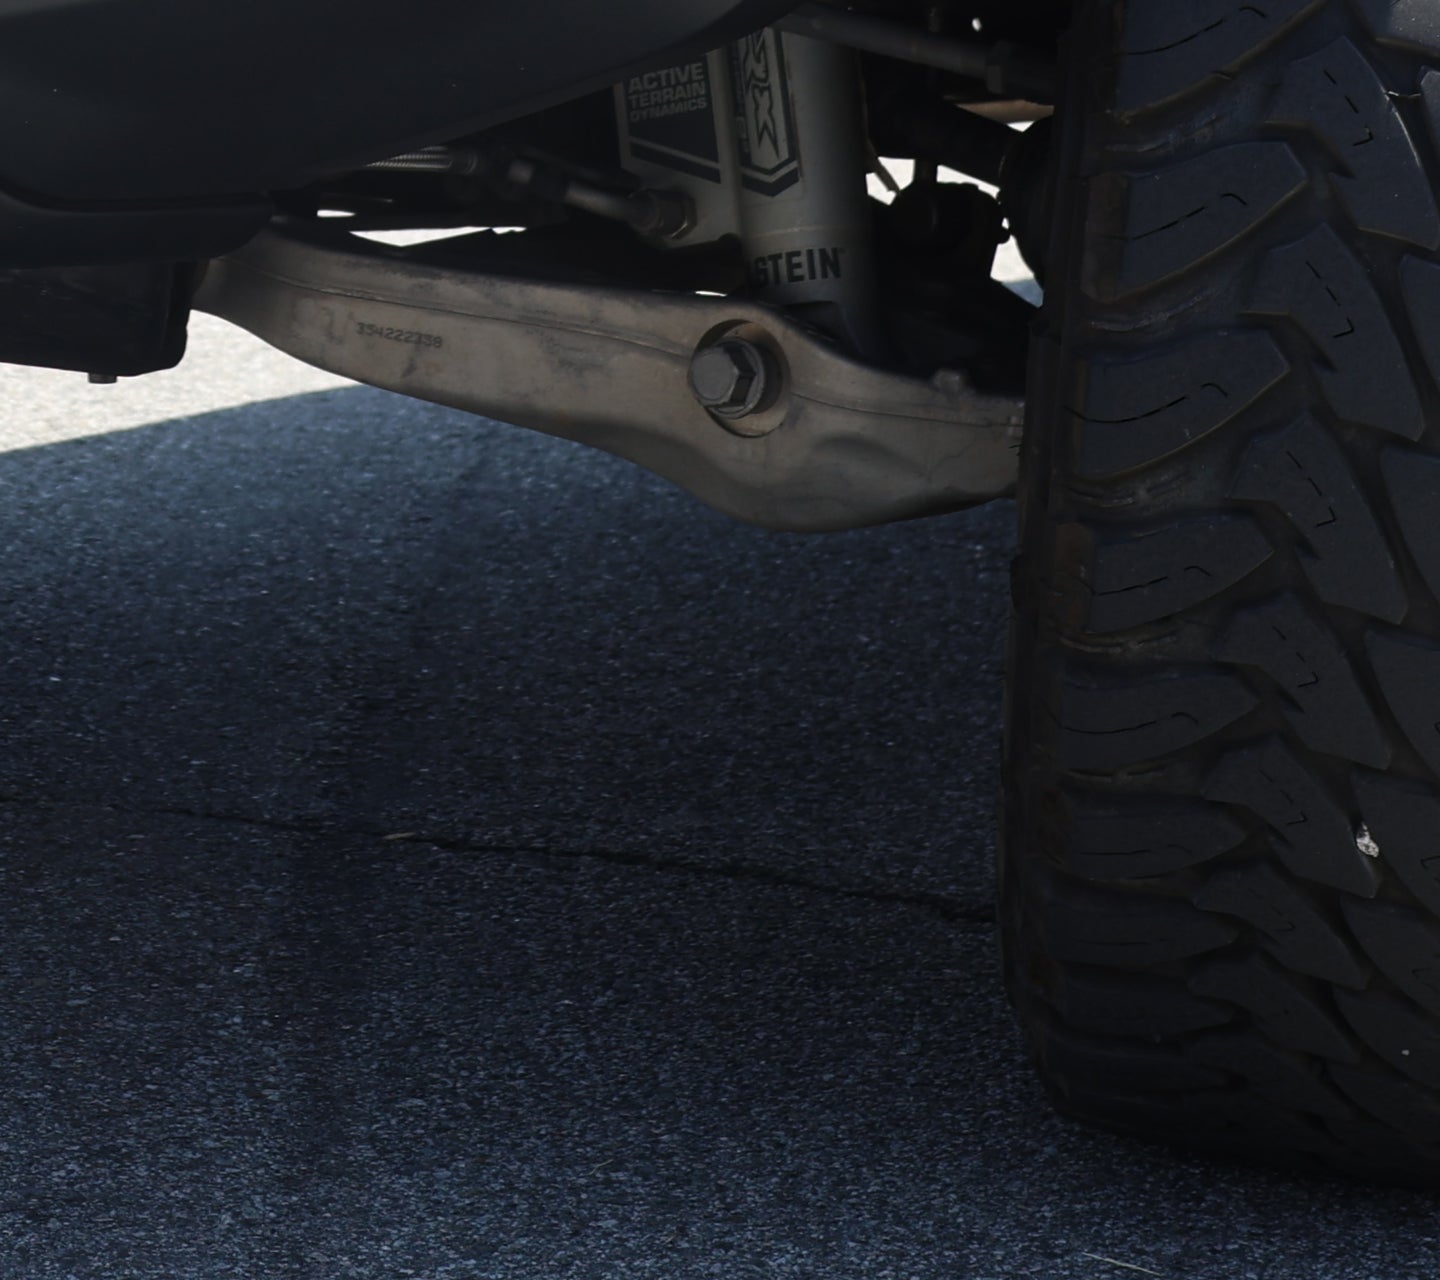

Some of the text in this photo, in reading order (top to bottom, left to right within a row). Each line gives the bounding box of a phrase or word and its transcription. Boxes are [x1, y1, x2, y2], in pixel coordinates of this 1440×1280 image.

[627, 61, 704, 94] ACTIVE
[627, 80, 706, 110] TERRAIN
[629, 96, 708, 123] DYNAMICS
